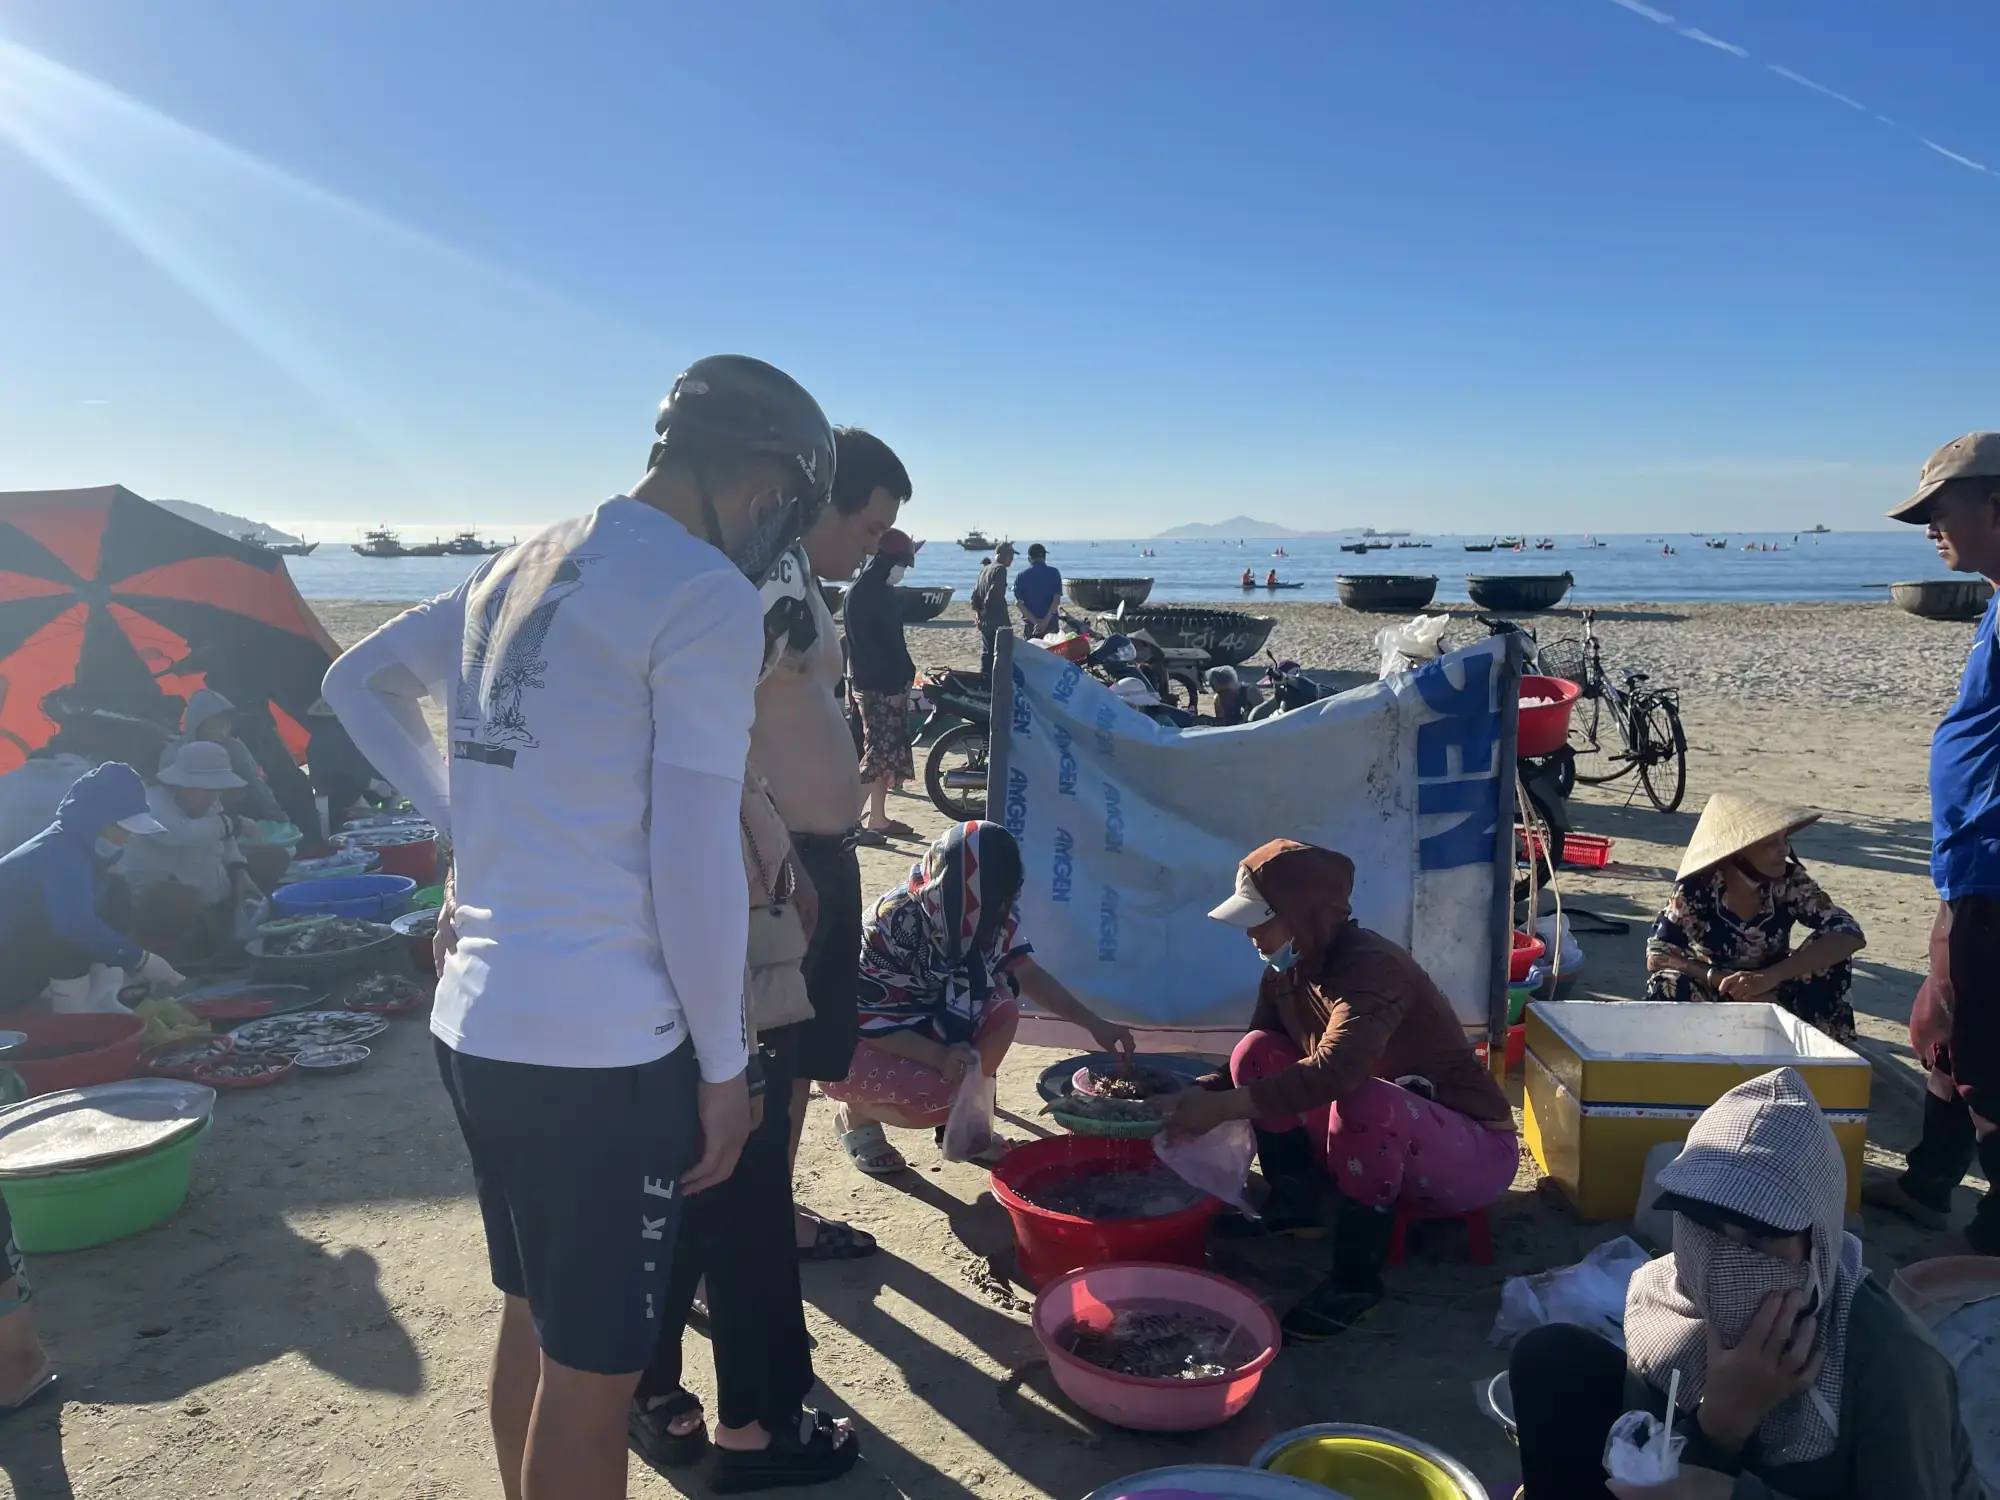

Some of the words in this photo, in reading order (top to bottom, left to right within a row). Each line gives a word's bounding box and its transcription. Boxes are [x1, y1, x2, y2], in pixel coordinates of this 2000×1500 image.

[1052, 663, 1084, 704] GEN
[1054, 724, 1078, 796] AMGEN
[1102, 782, 1125, 854] AMGEN
[1052, 826, 1074, 901] AMGEN
[1099, 884, 1120, 961] AMGEN
